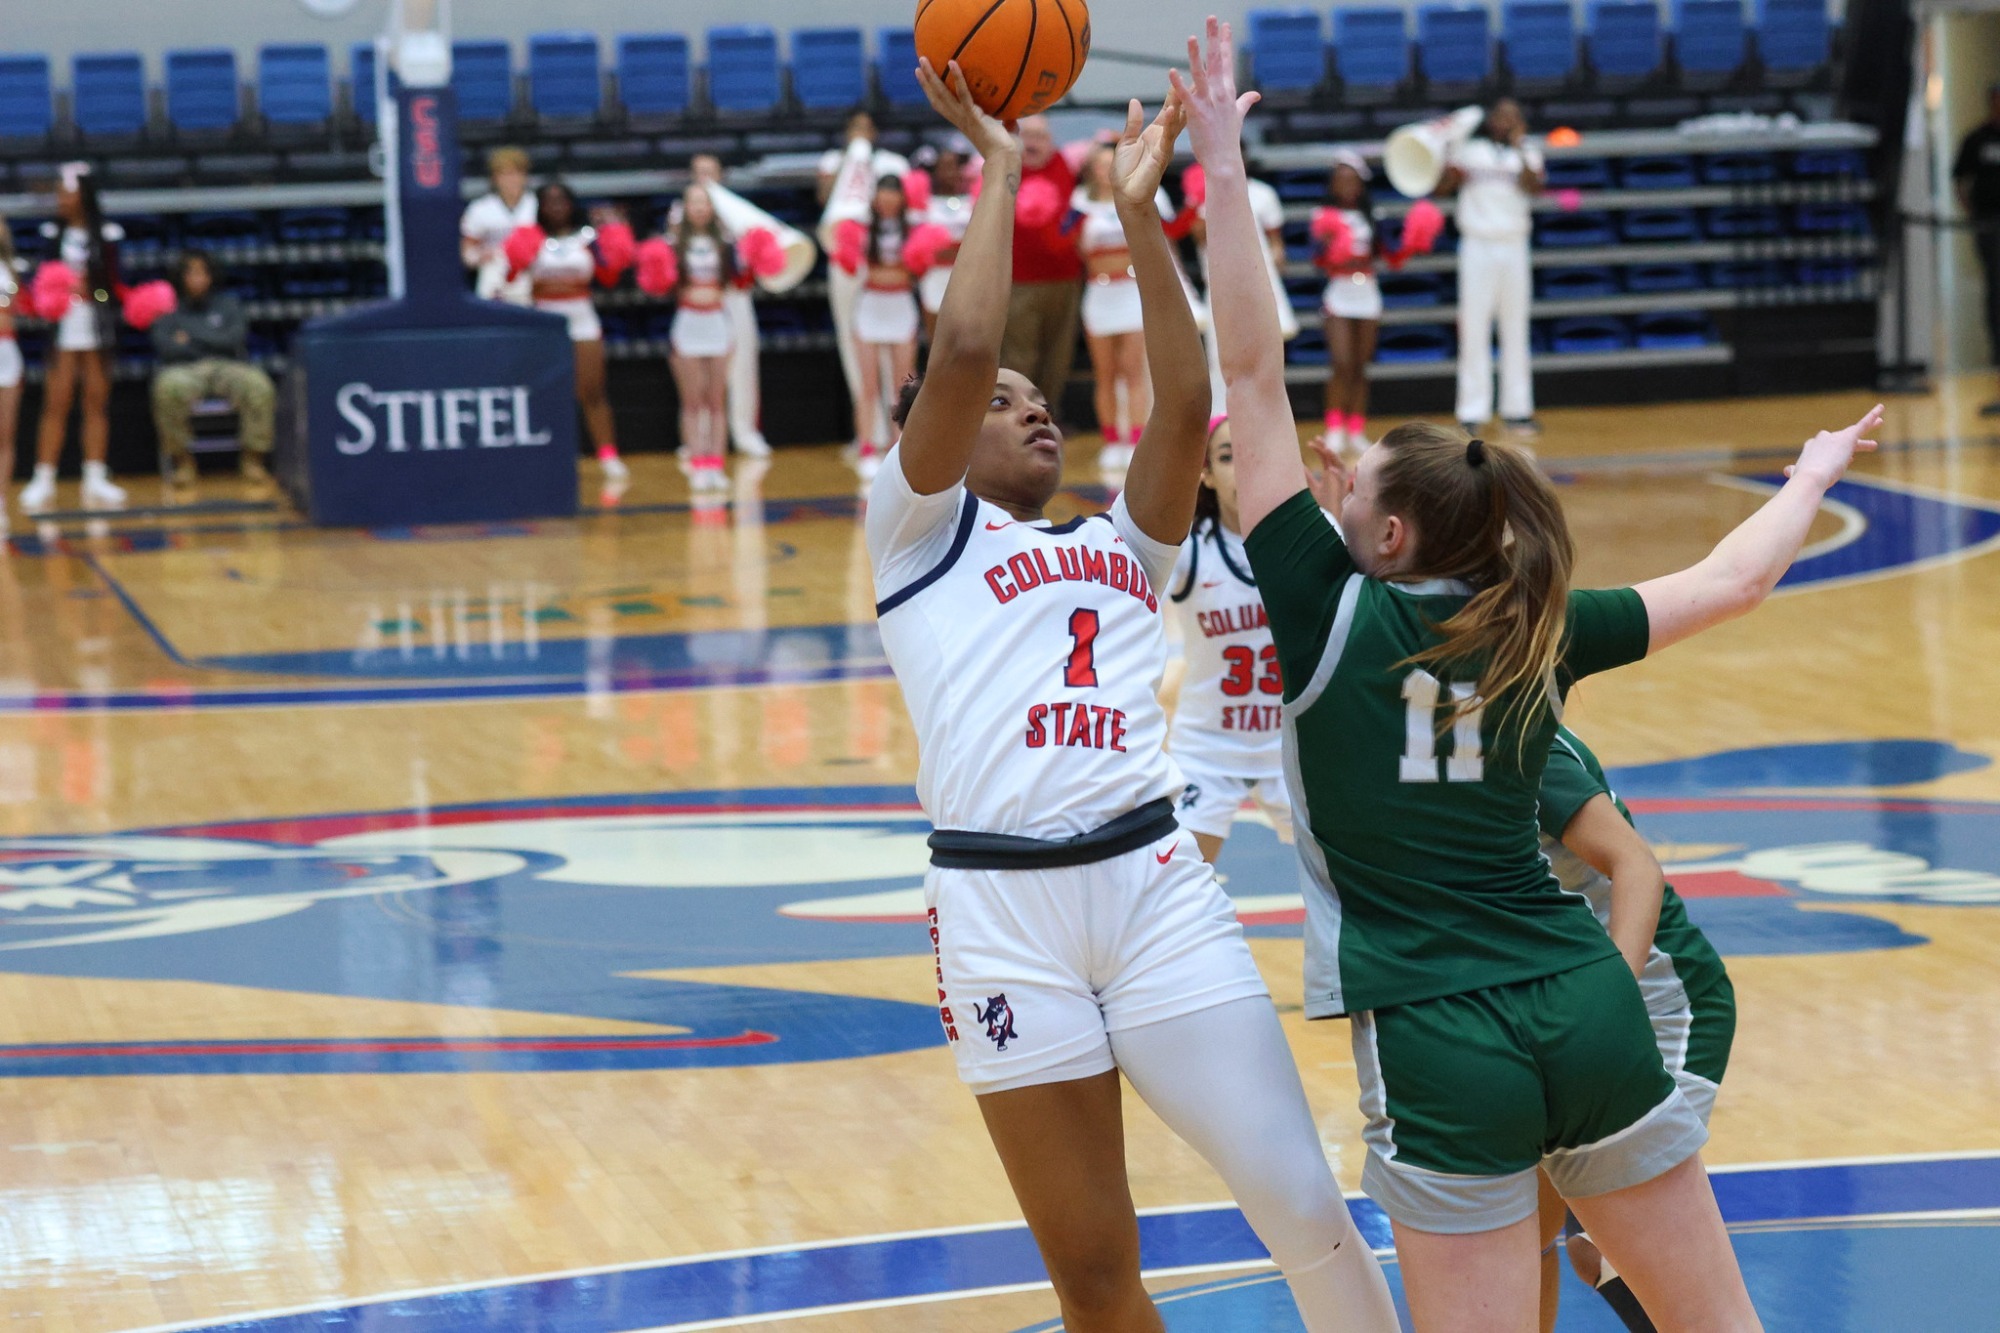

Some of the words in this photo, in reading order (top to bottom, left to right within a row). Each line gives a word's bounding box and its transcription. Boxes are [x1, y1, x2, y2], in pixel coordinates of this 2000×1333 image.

[335, 381, 552, 456] STIFEL
[1063, 607, 1100, 688] 1
[1220, 644, 1284, 697] 33
[1025, 702, 1127, 753] STATE
[1398, 667, 1484, 783] 11
